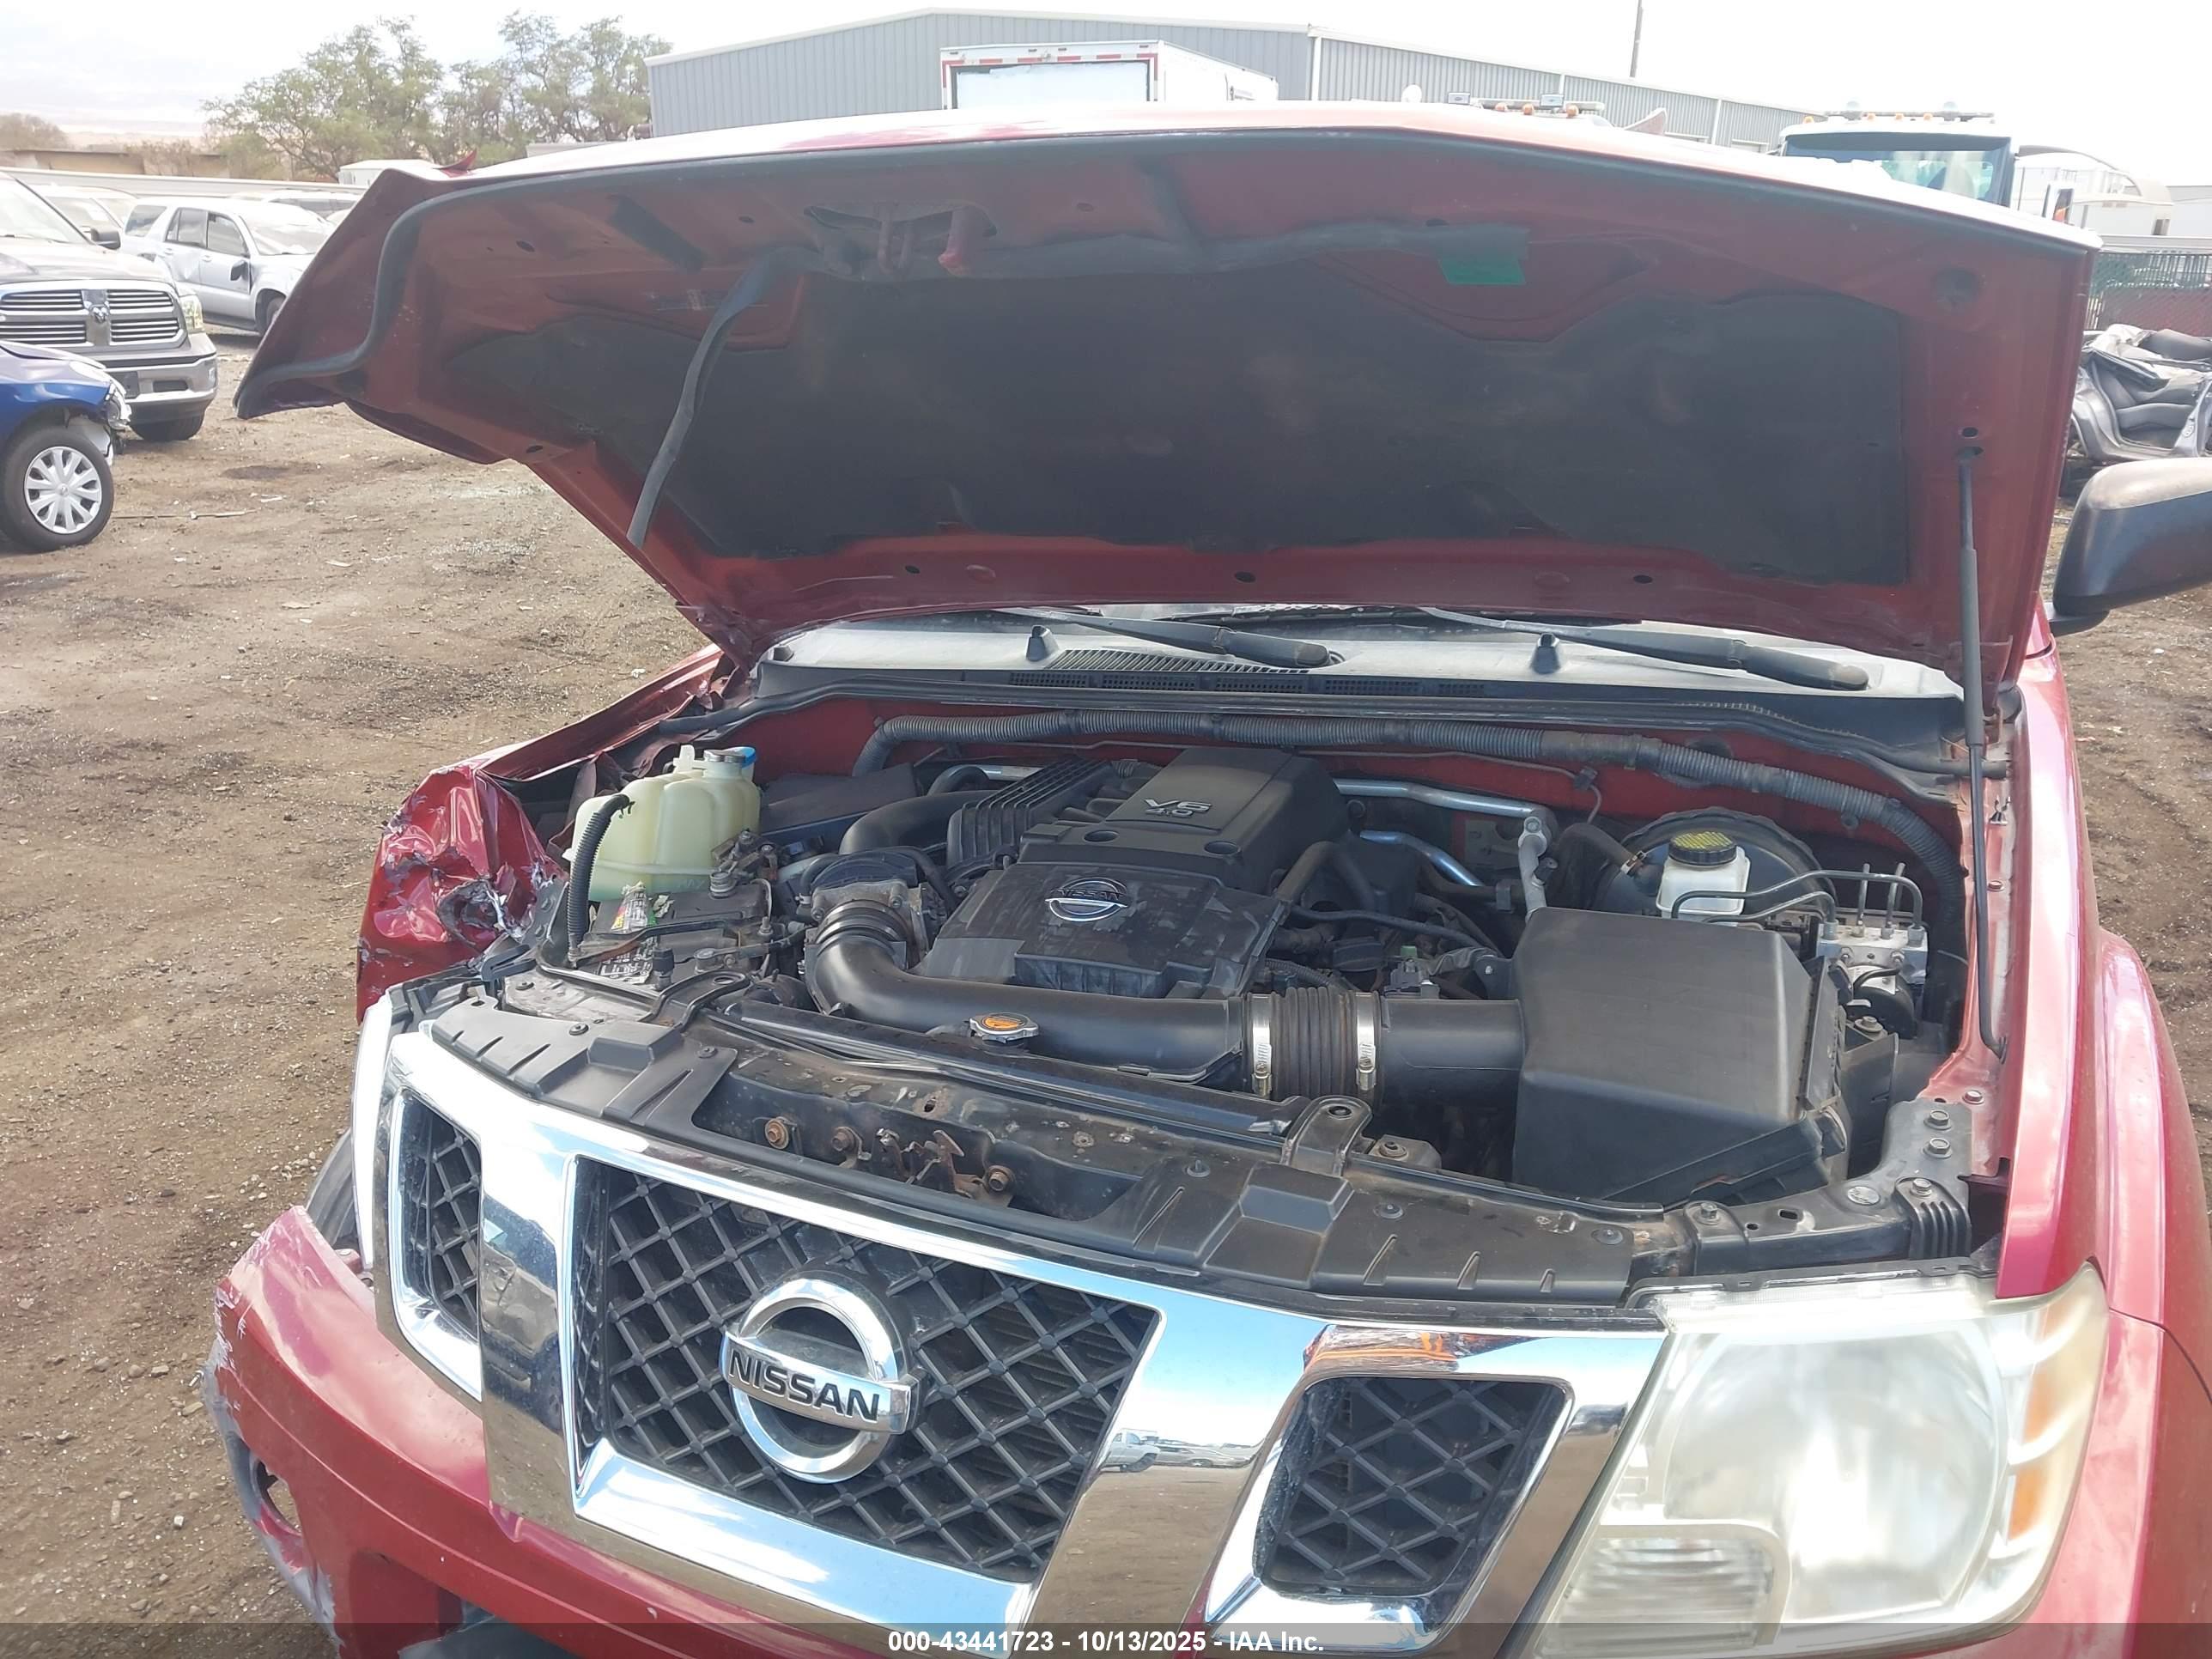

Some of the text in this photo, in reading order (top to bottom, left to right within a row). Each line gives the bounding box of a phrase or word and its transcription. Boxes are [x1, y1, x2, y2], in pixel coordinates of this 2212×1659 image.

[1145, 799, 1212, 813] V6
[1145, 807, 1194, 817] 4.0
[1054, 888, 1122, 901] NISSAN
[729, 1350, 880, 1423] NISSAN
